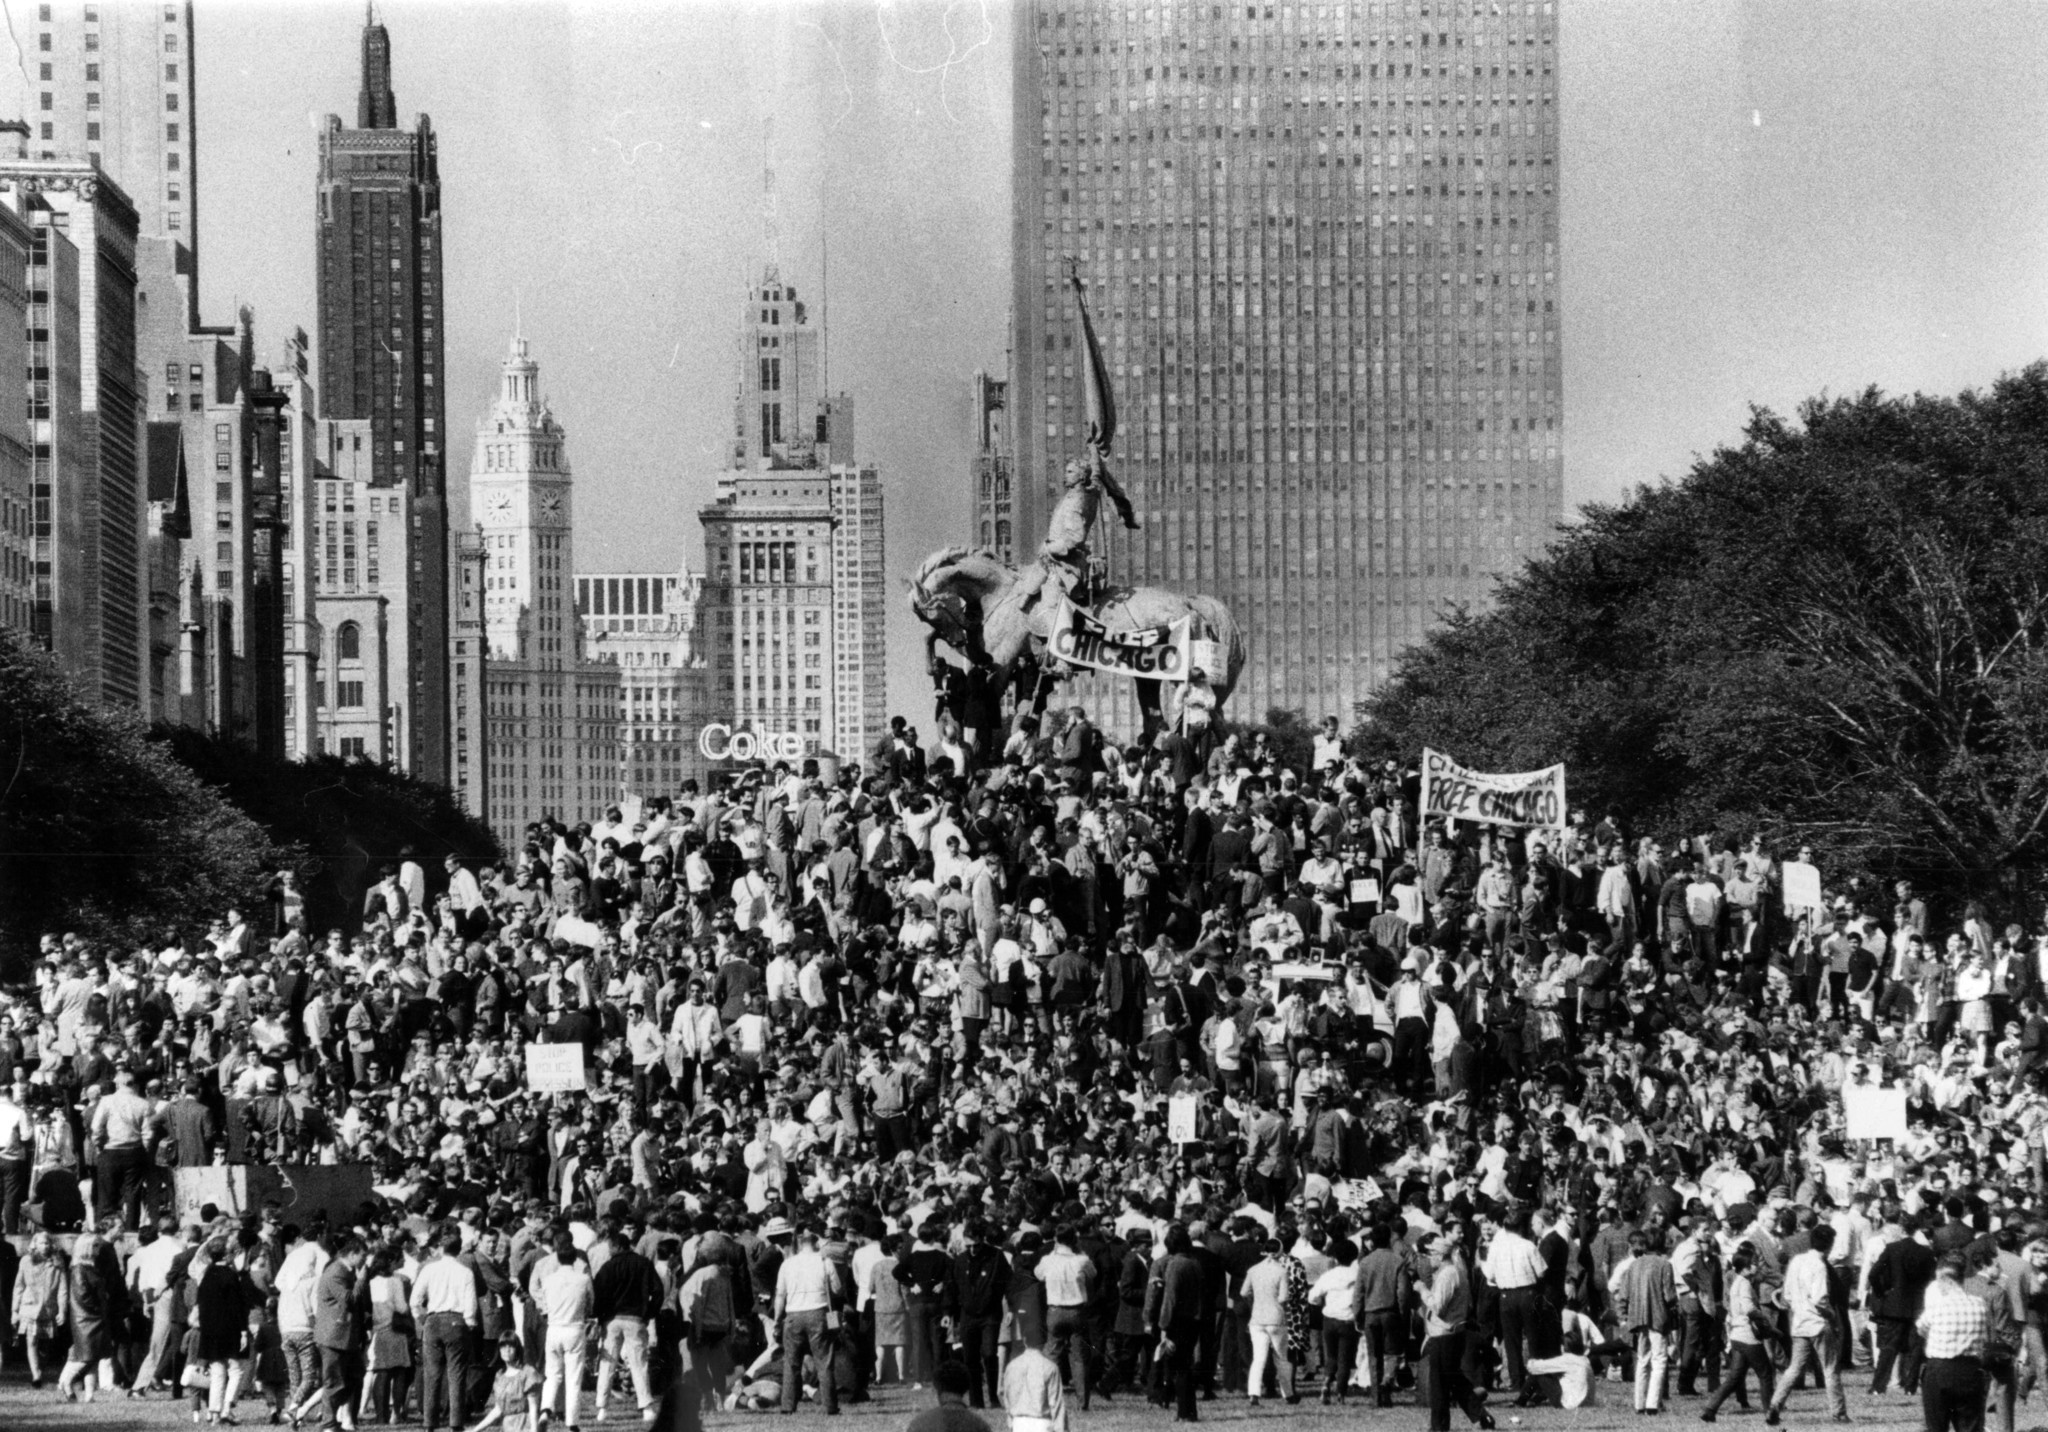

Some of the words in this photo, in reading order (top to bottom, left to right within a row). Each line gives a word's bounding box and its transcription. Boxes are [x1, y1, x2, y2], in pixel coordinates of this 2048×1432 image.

[1056, 627, 1182, 675] CHICAGO
[699, 722, 805, 760] Coke
[1545, 770, 1555, 785] A
[1427, 776, 1477, 814] FREE
[1479, 789, 1559, 824] CHICAGO
[540, 1047, 568, 1059] STOP
[535, 1062, 573, 1073] POLICE
